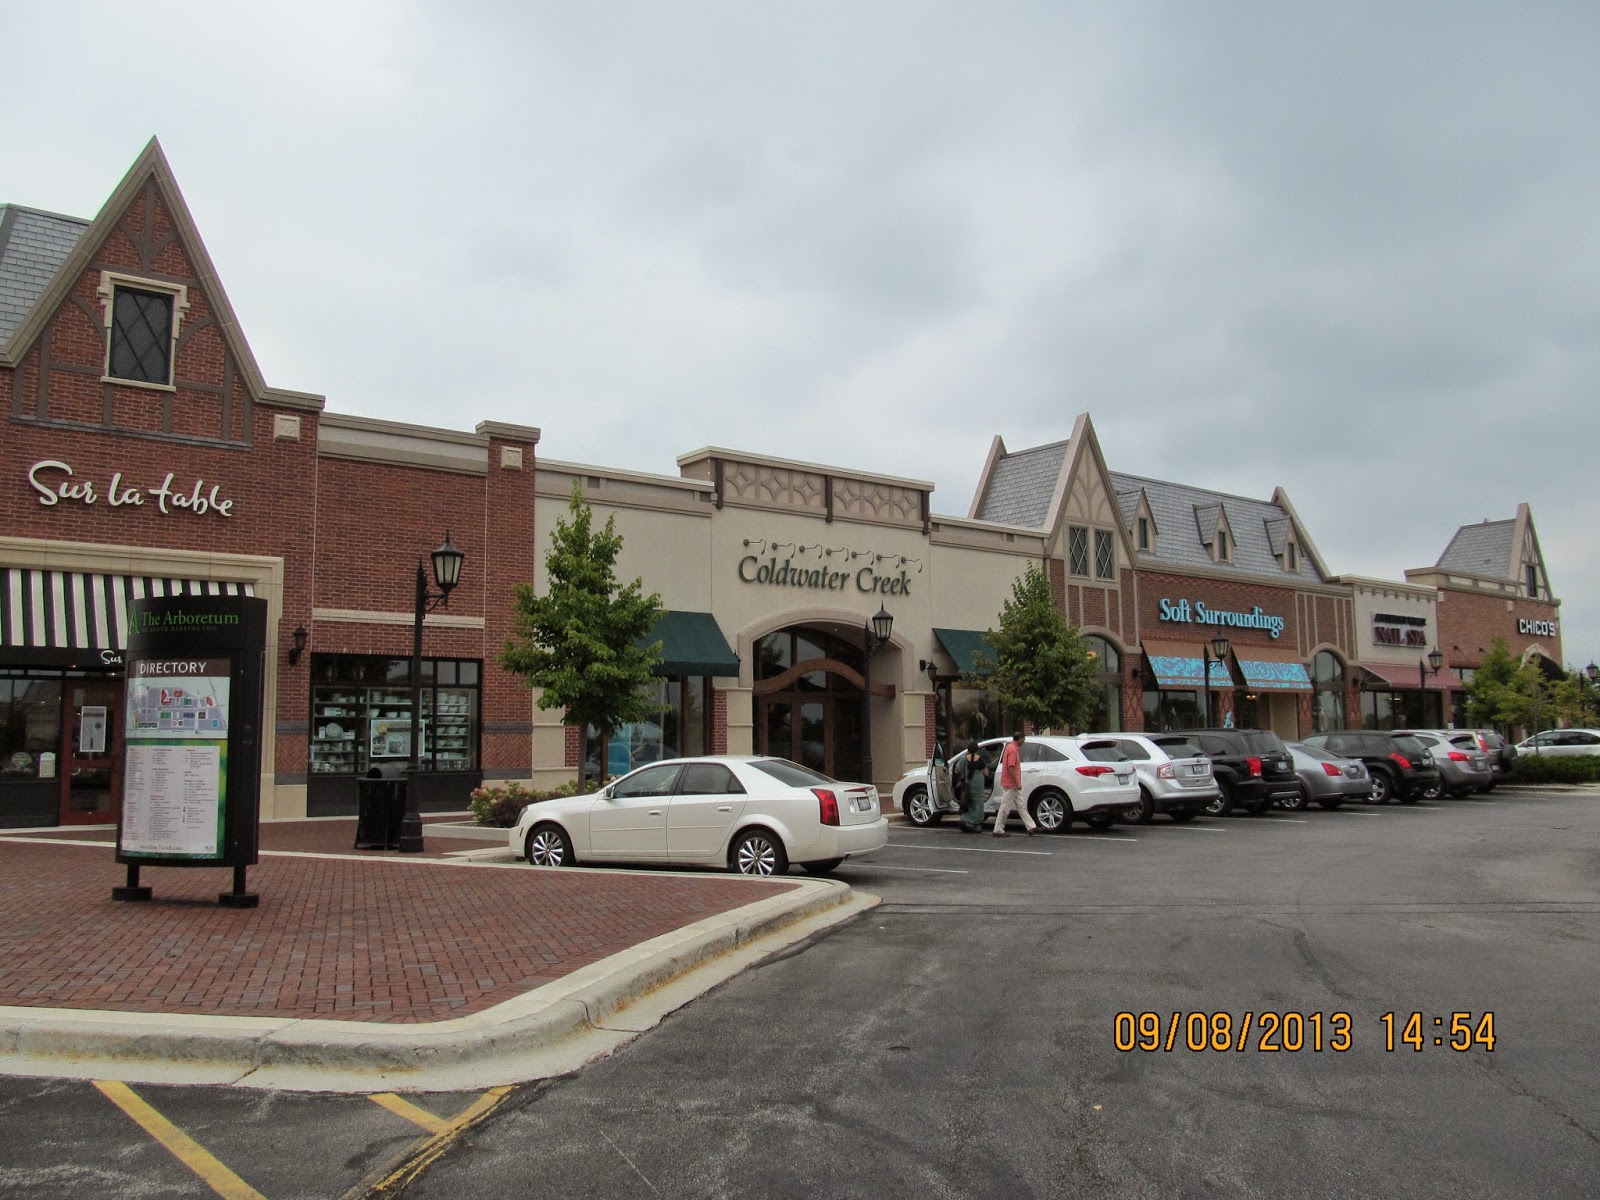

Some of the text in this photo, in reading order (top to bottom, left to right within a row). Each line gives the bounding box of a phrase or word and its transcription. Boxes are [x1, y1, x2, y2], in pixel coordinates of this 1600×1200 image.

[29, 460, 233, 516] Sur la table
[738, 555, 911, 596] Coldwater Creek
[142, 610, 239, 626] The Arboretum
[1159, 598, 1284, 639] Soft Surroundings
[1518, 618, 1556, 637] CHICO'S
[100, 650, 123, 665] Sur
[140, 662, 207, 674] DIRECTORY
